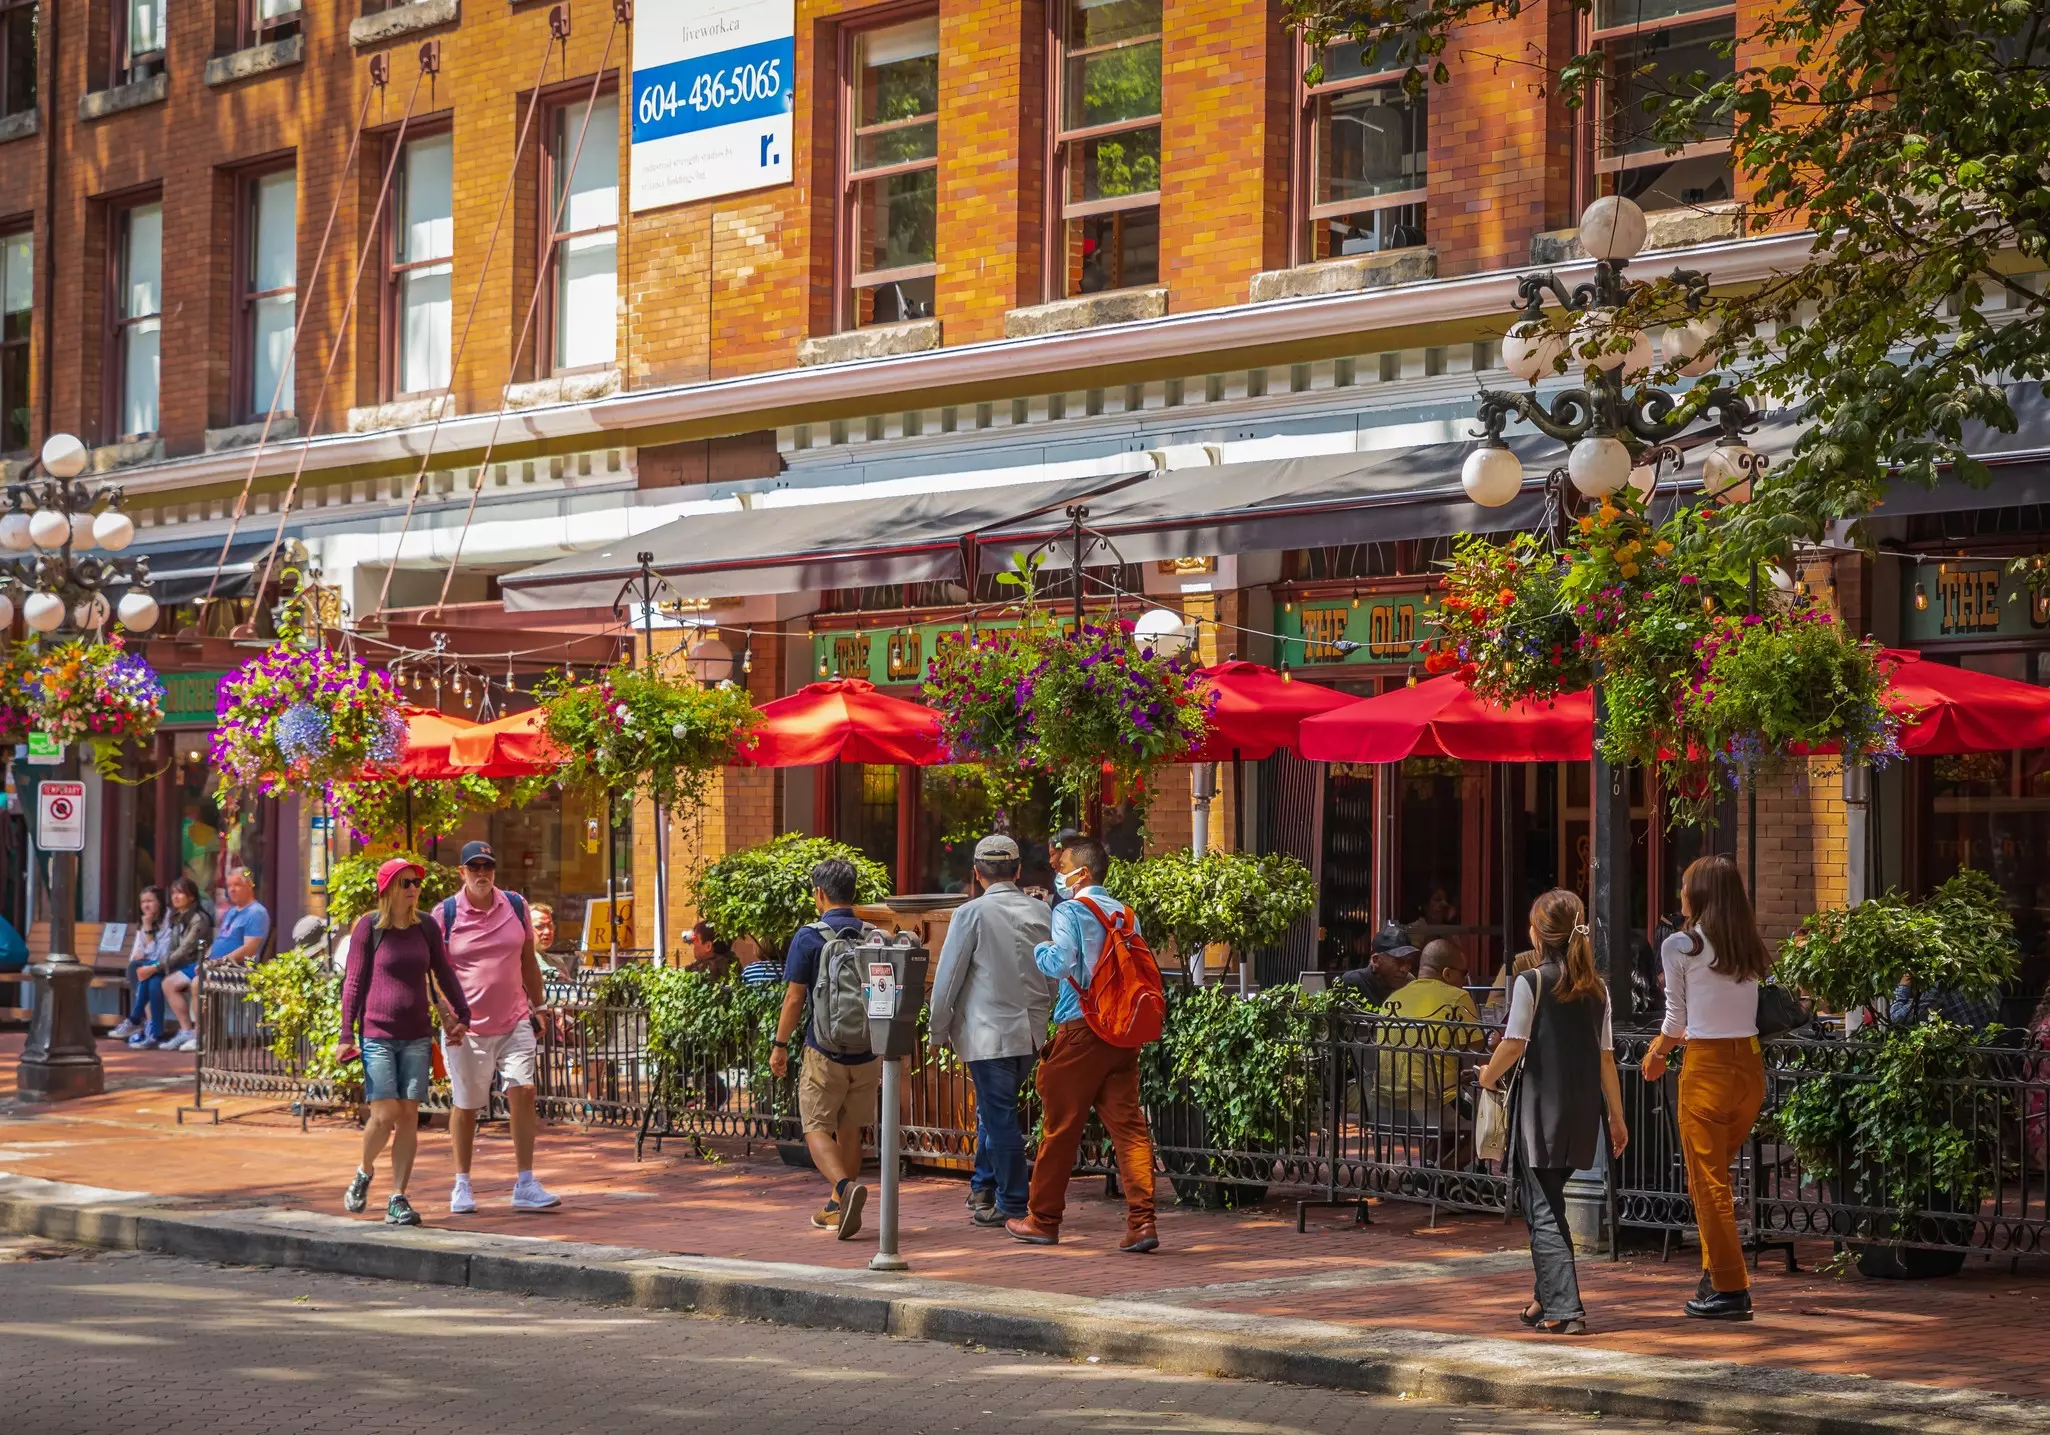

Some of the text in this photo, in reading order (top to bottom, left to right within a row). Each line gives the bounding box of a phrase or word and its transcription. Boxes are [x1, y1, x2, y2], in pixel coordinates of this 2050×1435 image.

[681, 17, 740, 43] livework.ca
[639, 58, 781, 124] 604-436-5065
[760, 133, 780, 167] r.
[1936, 568, 2000, 634] THE
[834, 636, 871, 678] THE
[887, 632, 922, 681] OLD
[1301, 607, 1348, 663] THE
[1369, 604, 1415, 659] OLD
